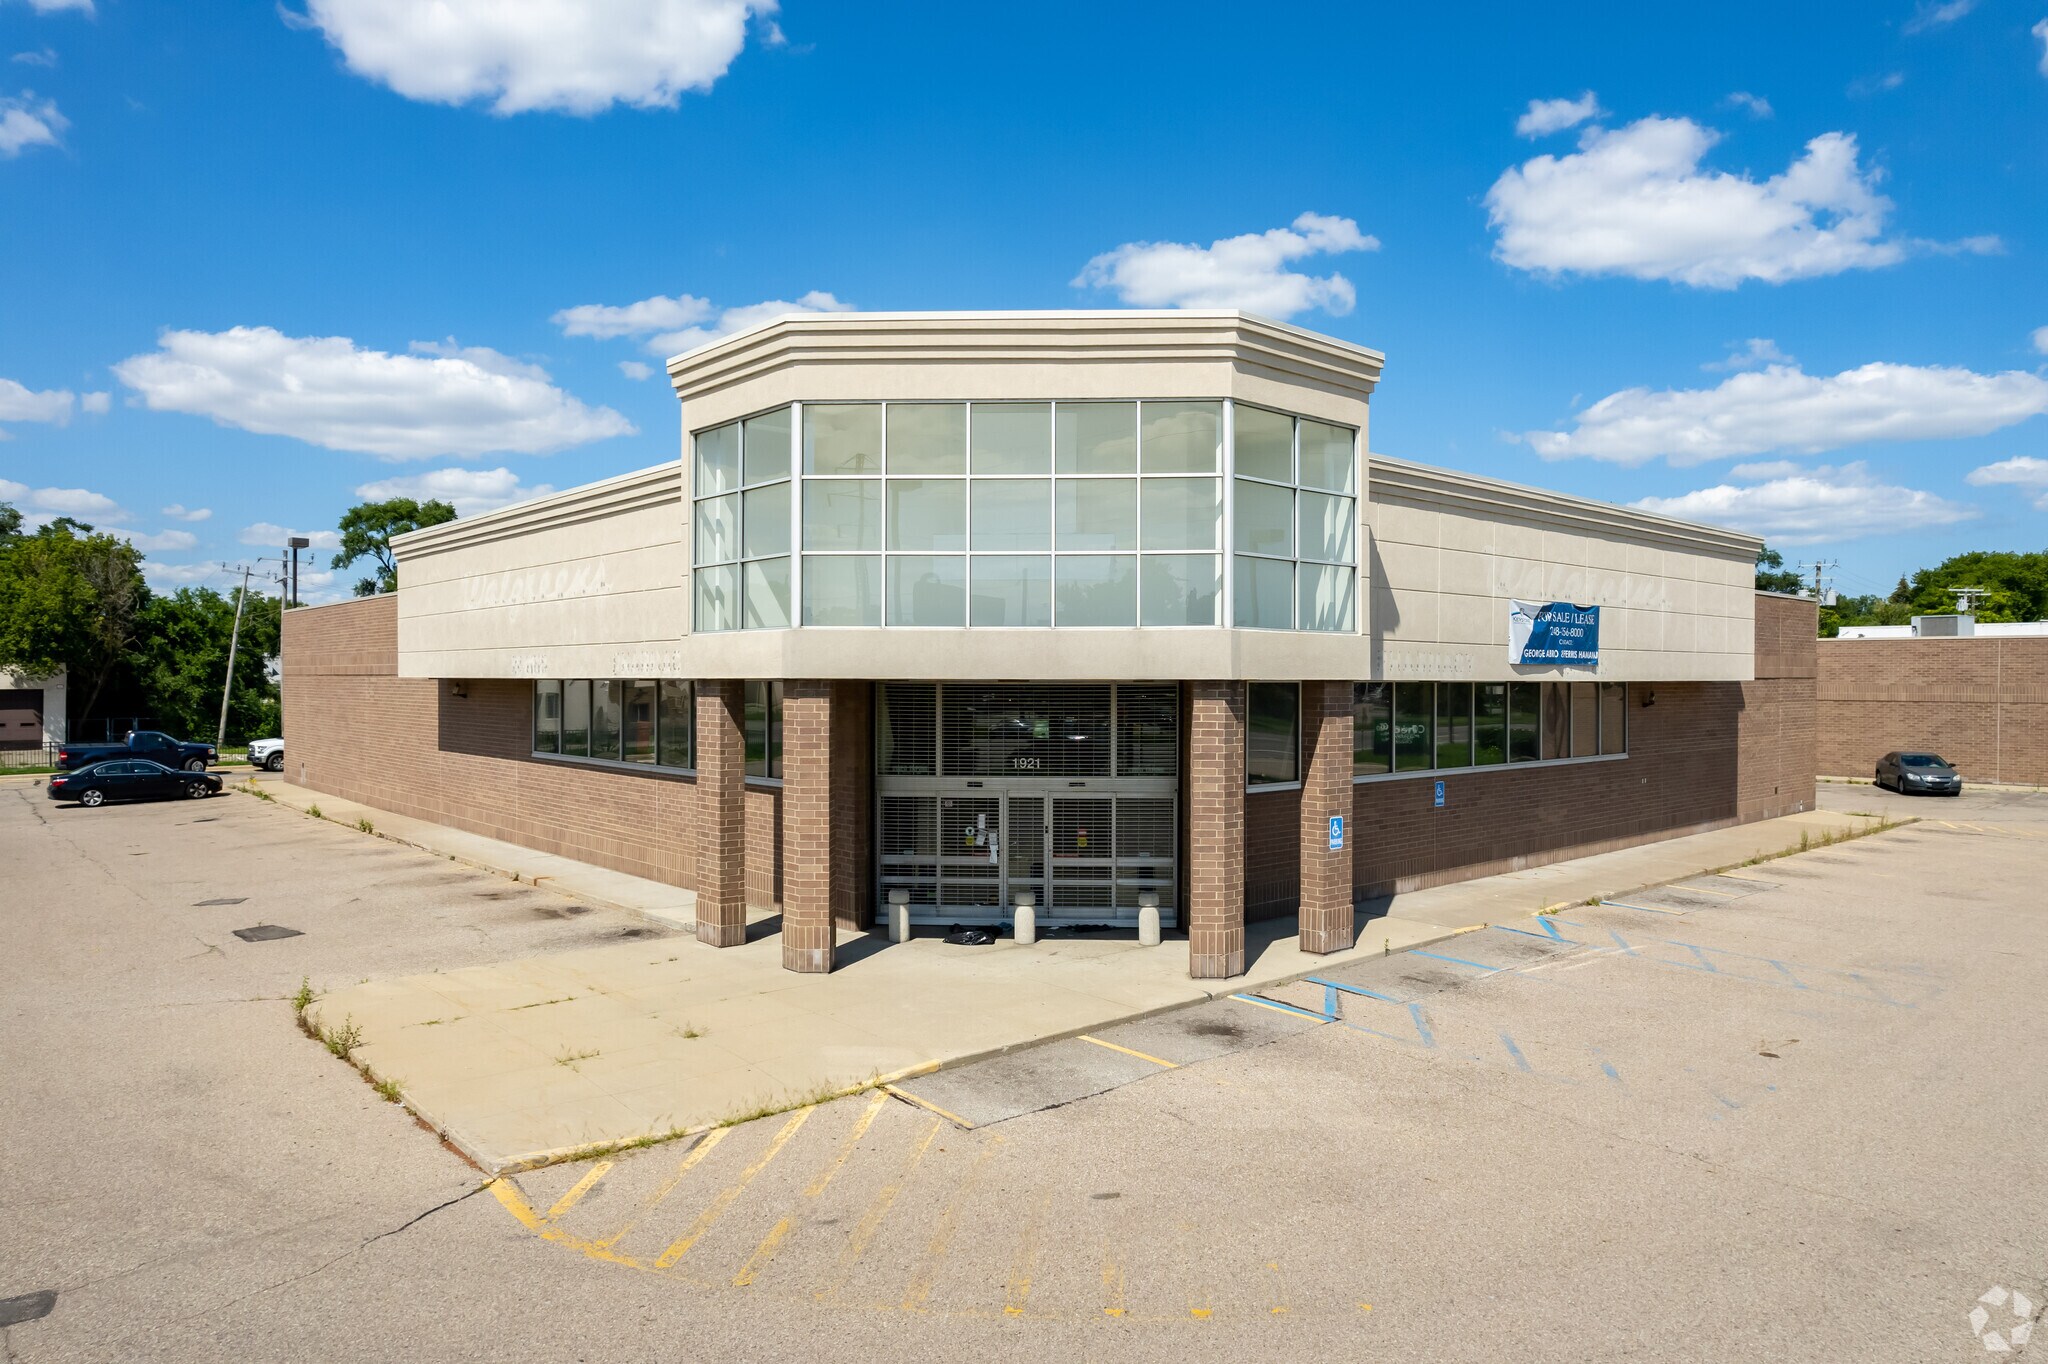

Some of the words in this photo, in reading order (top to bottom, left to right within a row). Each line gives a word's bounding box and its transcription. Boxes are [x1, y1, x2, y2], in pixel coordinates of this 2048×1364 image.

[1552, 612, 1570, 624] SALE
[1575, 613, 1595, 625] LEASE
[1524, 649, 1545, 658] GEORGE
[1012, 757, 1040, 769] 1921
